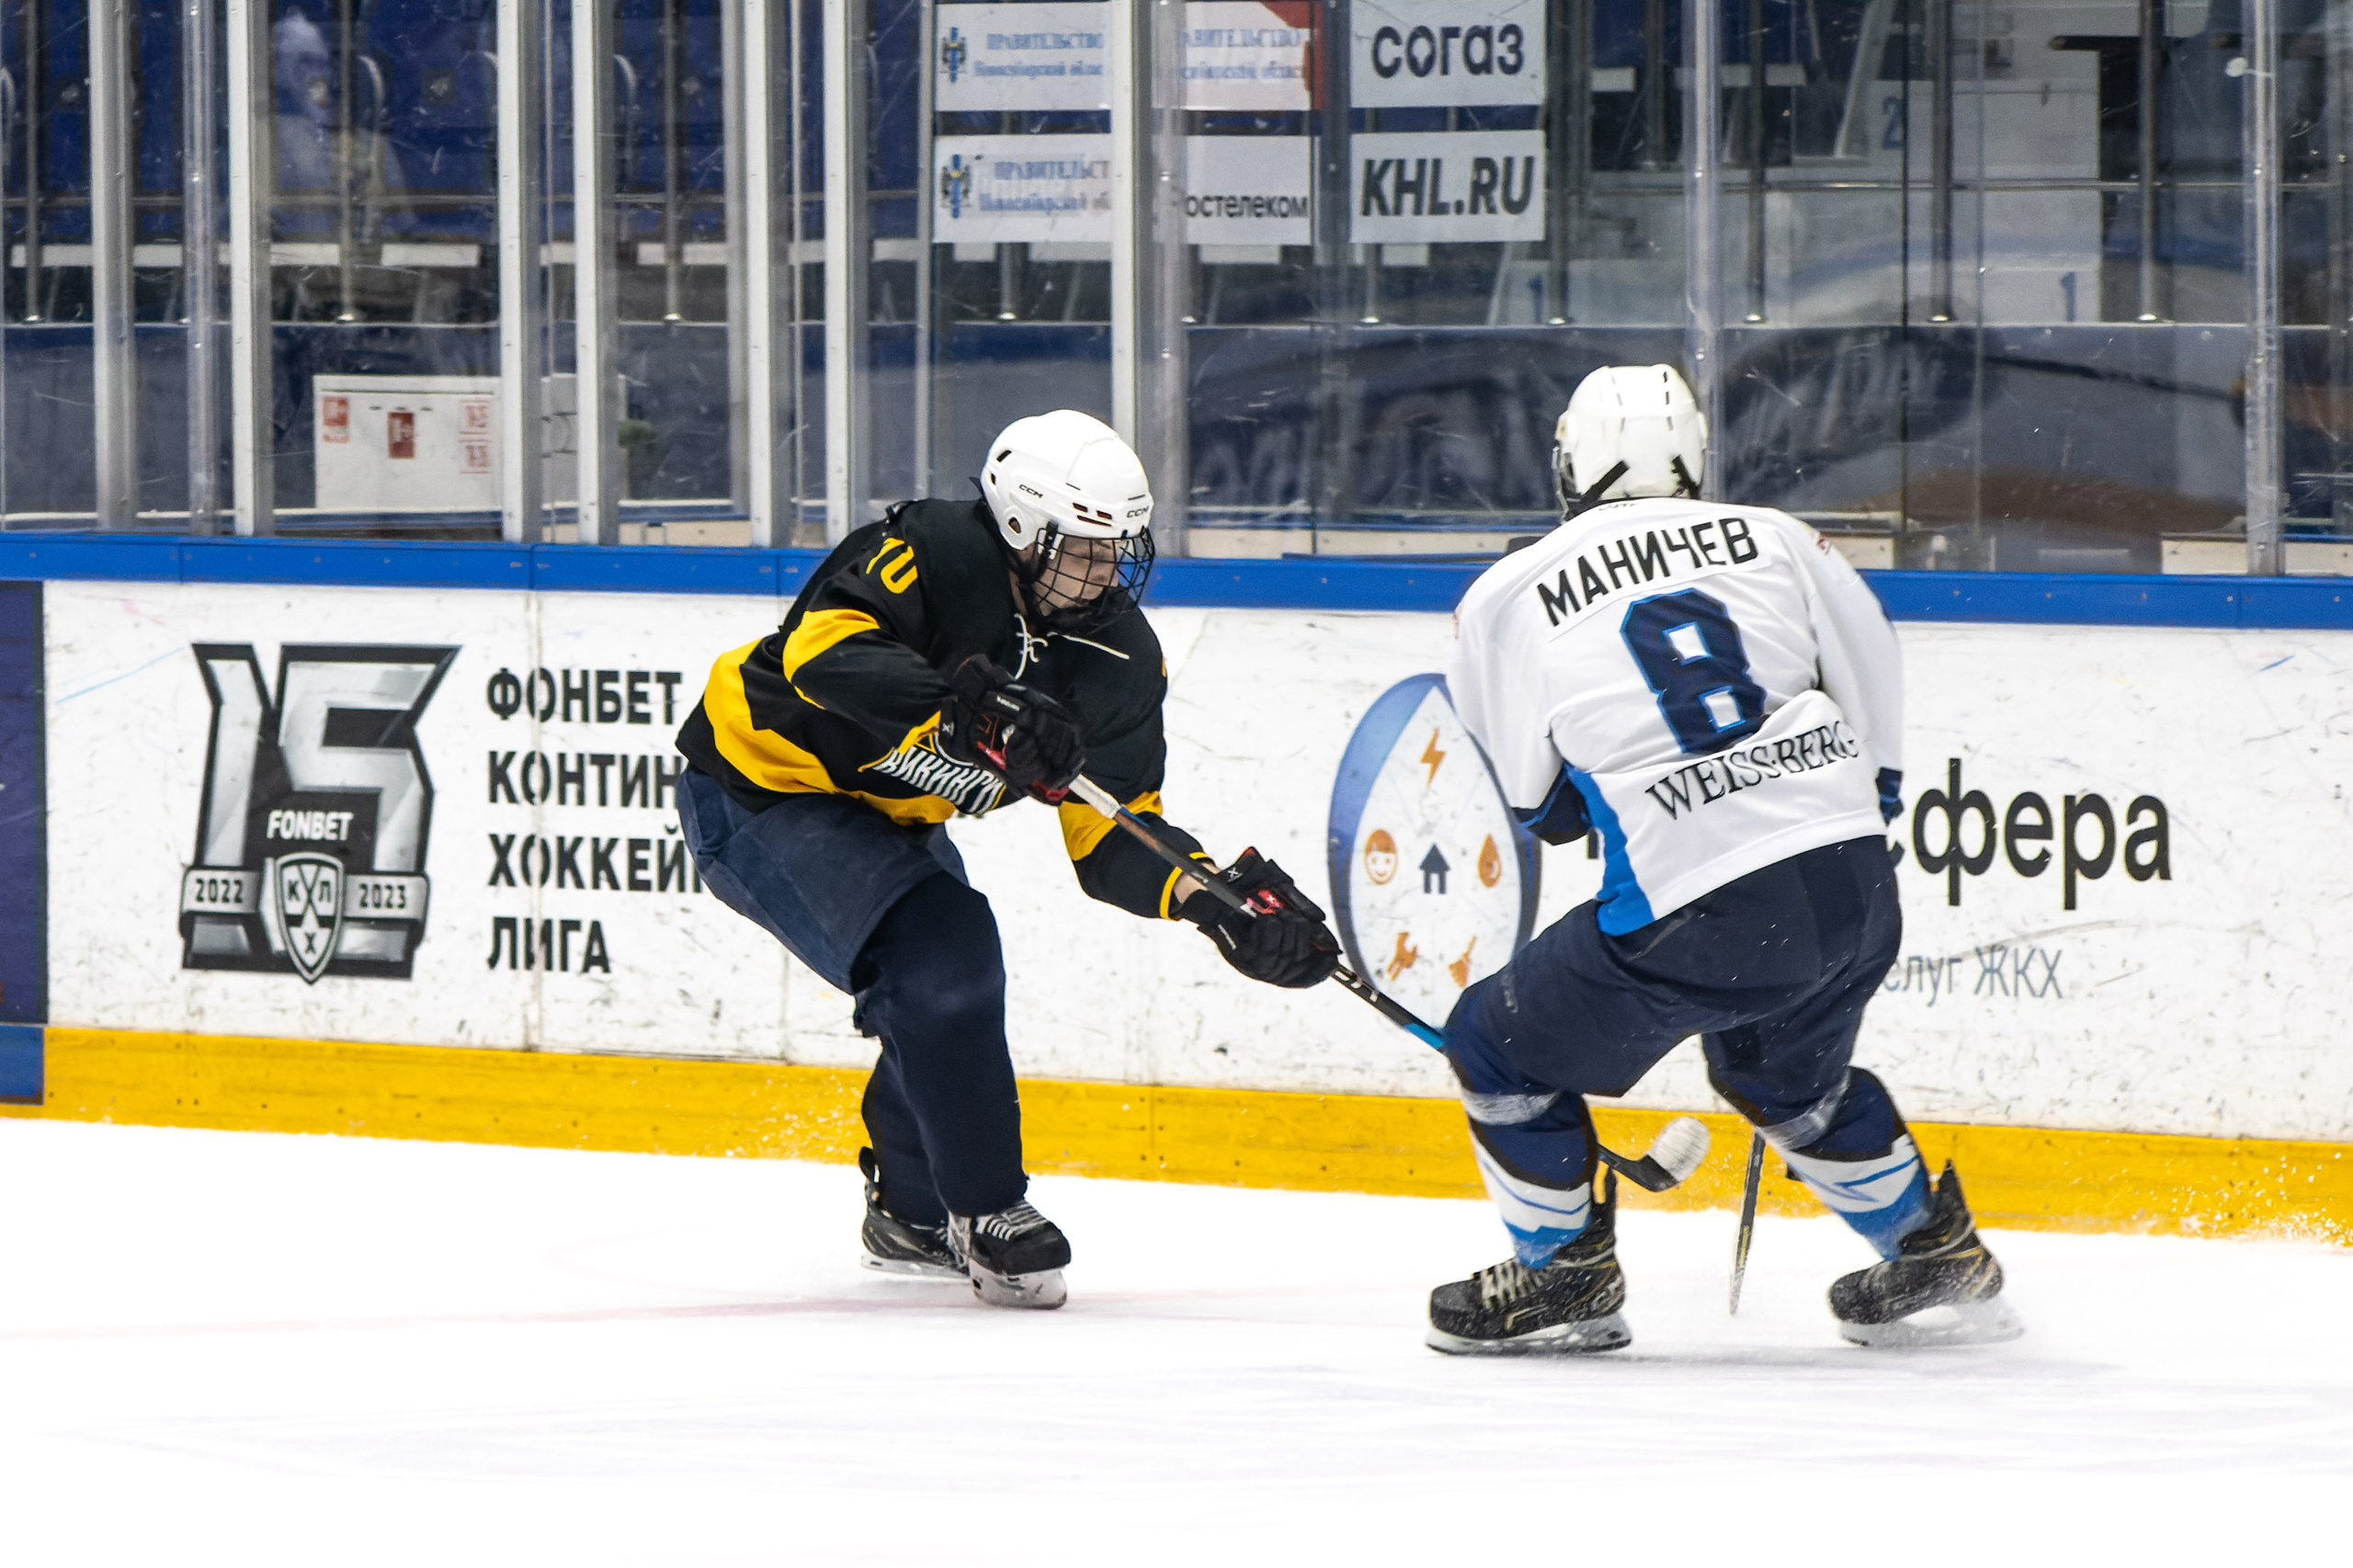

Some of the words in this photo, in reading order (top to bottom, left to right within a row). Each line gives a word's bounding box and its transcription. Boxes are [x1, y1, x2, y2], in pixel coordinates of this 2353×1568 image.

[1360, 155, 1535, 216] KHL.RU
[1018, 483, 1043, 498] CCM
[1537, 517, 1759, 628] МАНИЧЕВ
[487, 667, 683, 725] ФОНБЕТ
[1620, 586, 1768, 754] 8
[488, 750, 682, 809] КОНТИН
[267, 810, 354, 841] FONBET
[1890, 757, 2172, 911] фера
[488, 824, 702, 893] ХОККЕЙ
[195, 879, 244, 903] 2022
[359, 883, 407, 909] 2023
[487, 916, 611, 973] ЛИГА
[1974, 946, 2063, 999] ЖКХ
